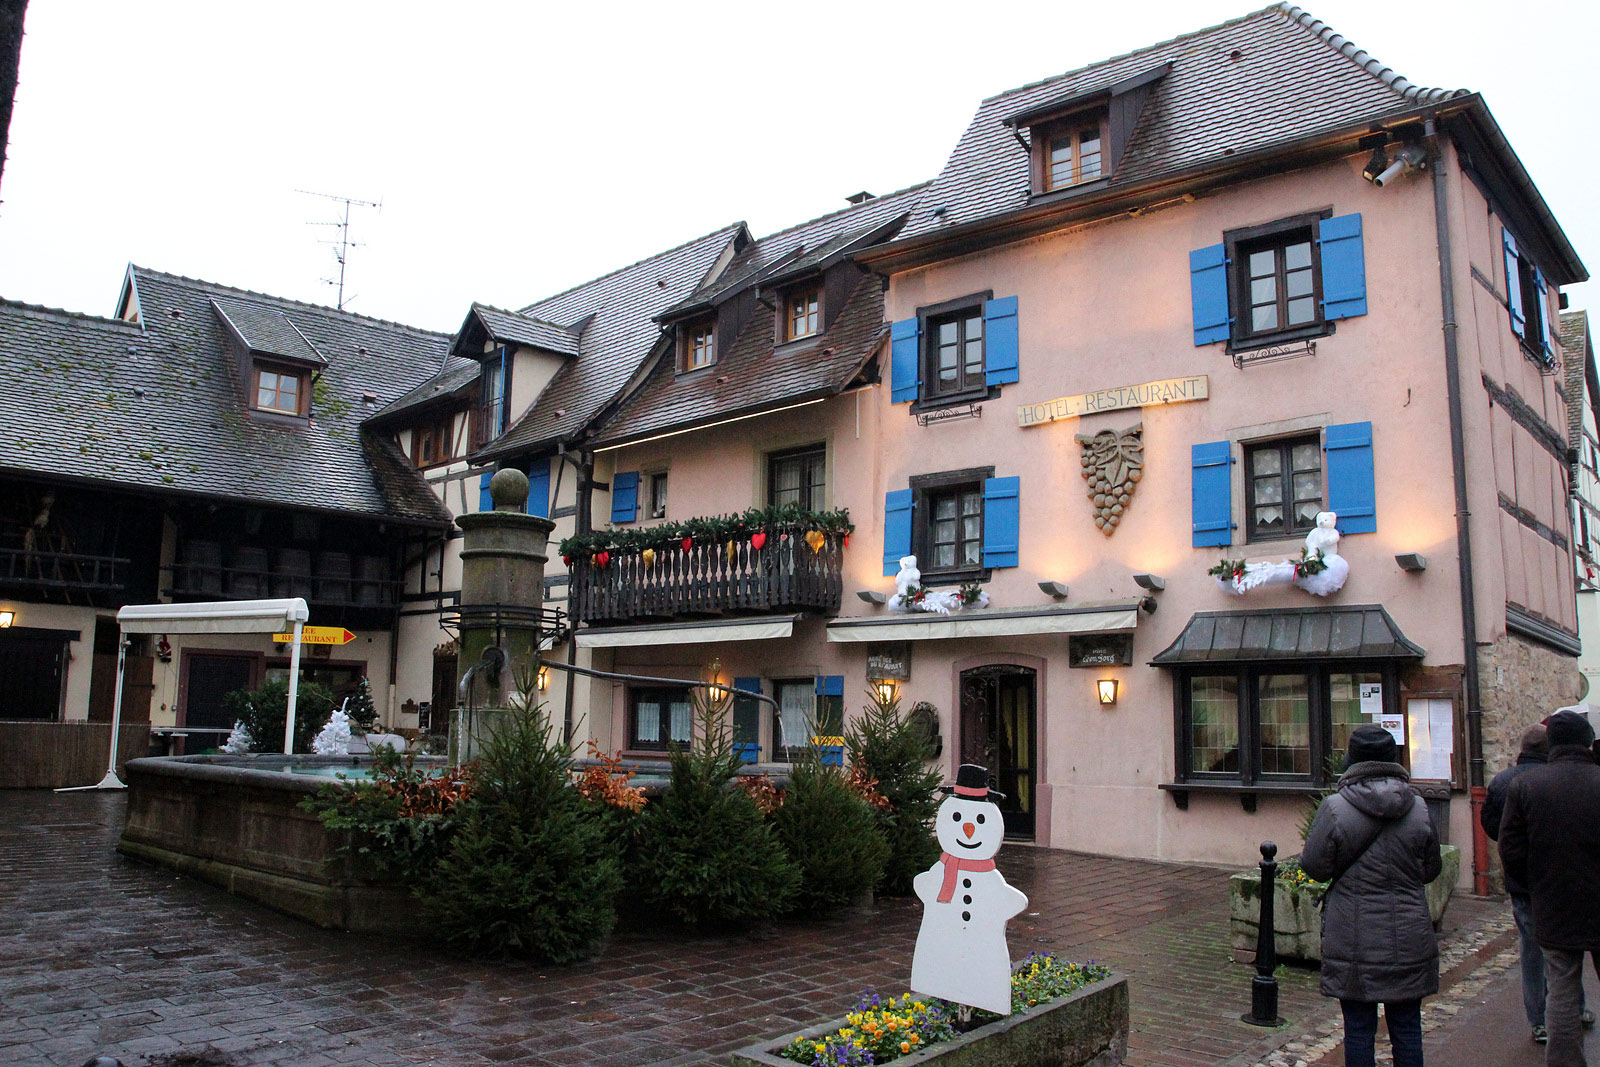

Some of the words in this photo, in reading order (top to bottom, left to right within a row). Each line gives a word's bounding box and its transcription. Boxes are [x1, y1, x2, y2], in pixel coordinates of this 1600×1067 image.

[1023, 399, 1074, 424] HOTEL
[1085, 379, 1200, 411] RESTAURANT
[282, 634, 337, 643] REAURANT
